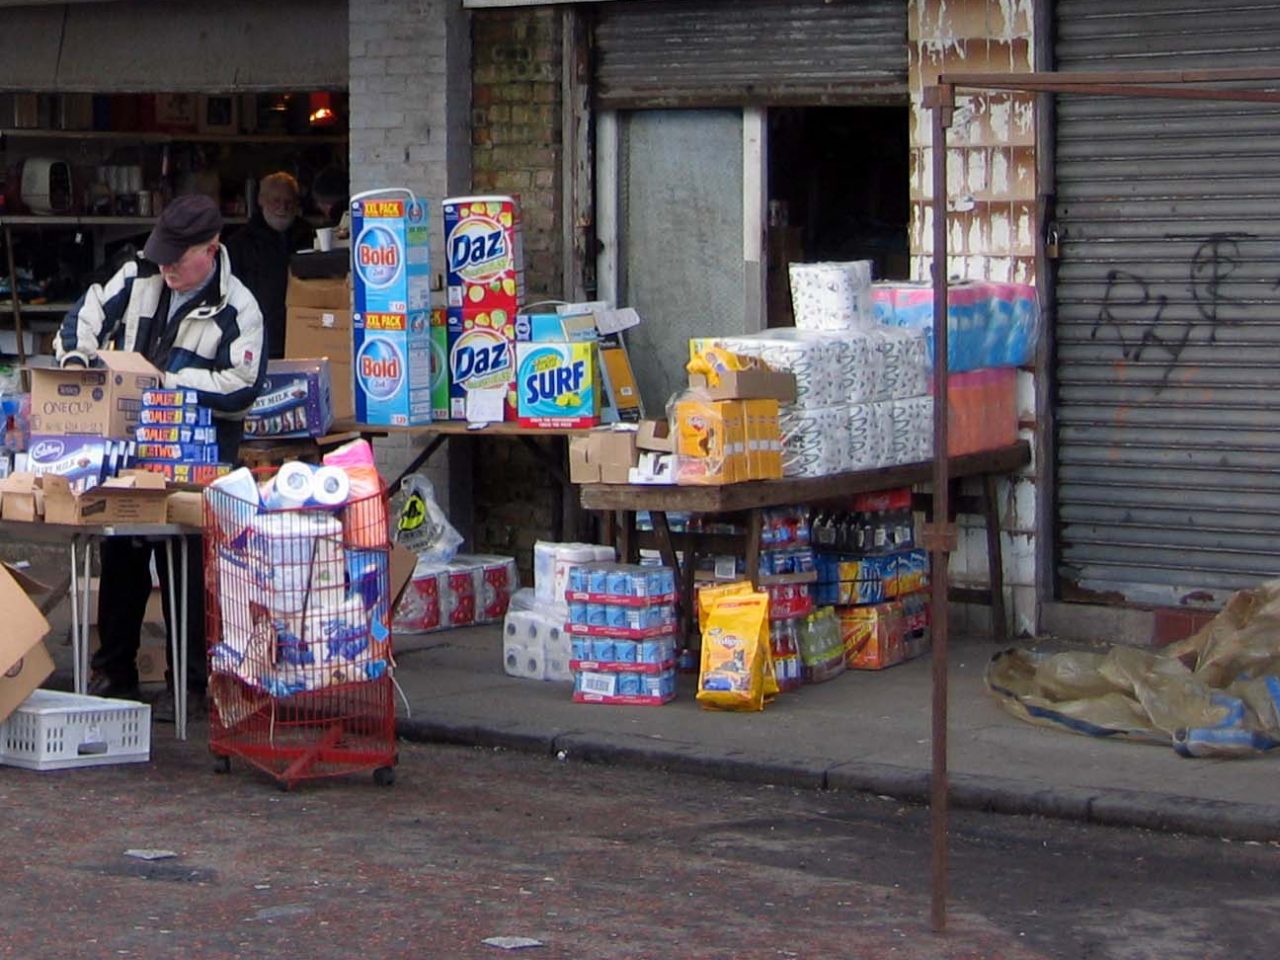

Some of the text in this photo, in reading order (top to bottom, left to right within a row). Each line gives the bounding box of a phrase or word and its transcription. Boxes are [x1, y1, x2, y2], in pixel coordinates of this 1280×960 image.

[381, 202, 400, 216] PACK
[361, 245, 396, 266] Bold
[452, 230, 504, 270] Daz
[381, 314, 402, 329] PACK
[362, 357, 398, 378] Bold
[455, 343, 508, 381] Daz
[527, 361, 584, 404] SURF
